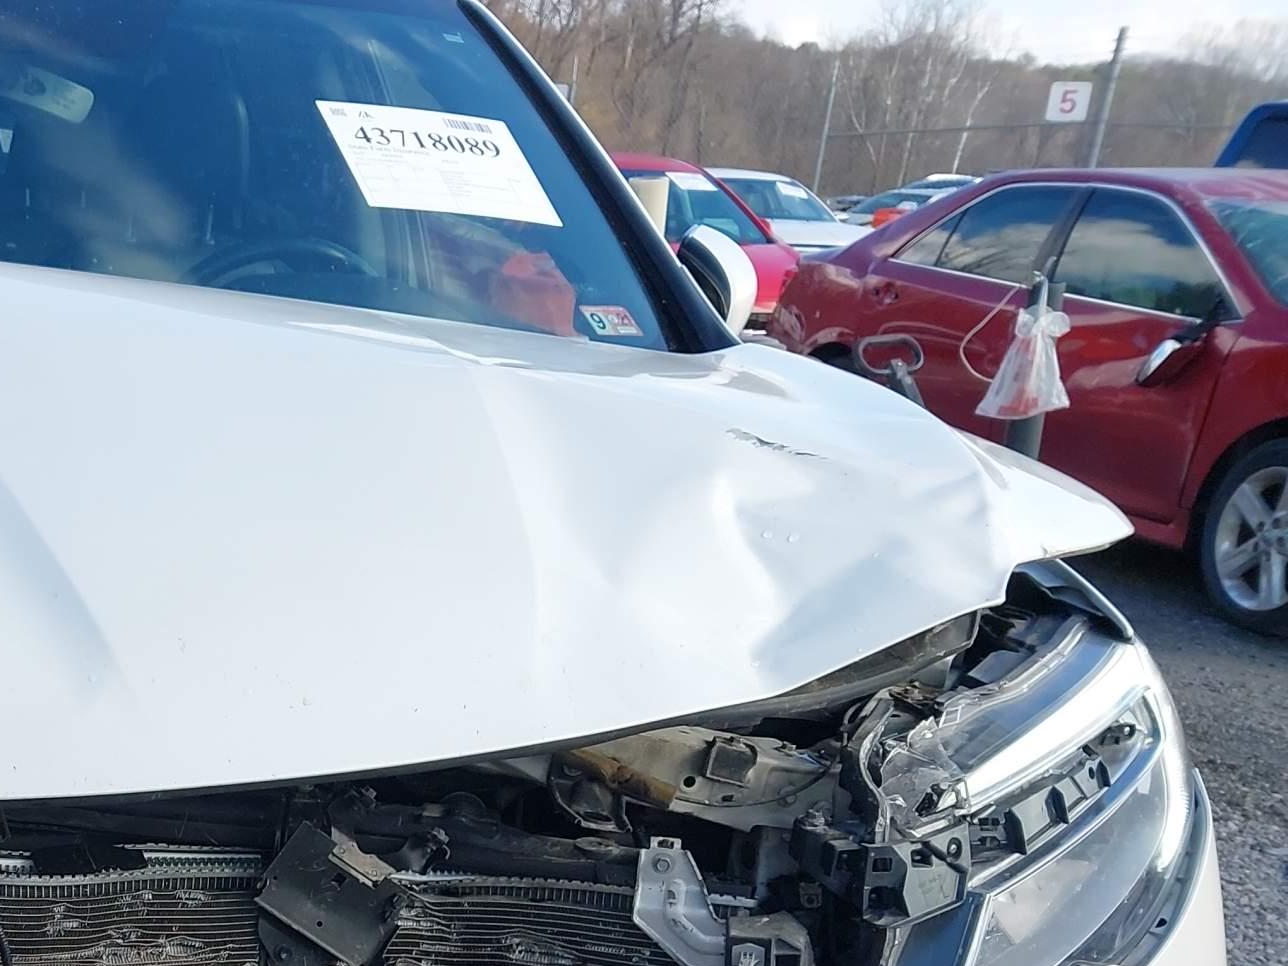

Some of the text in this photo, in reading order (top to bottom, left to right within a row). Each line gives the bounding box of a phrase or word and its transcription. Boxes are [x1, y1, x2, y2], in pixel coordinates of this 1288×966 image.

[1059, 89, 1078, 114] 5
[353, 125, 501, 158] 43718089
[589, 312, 607, 330] 9
